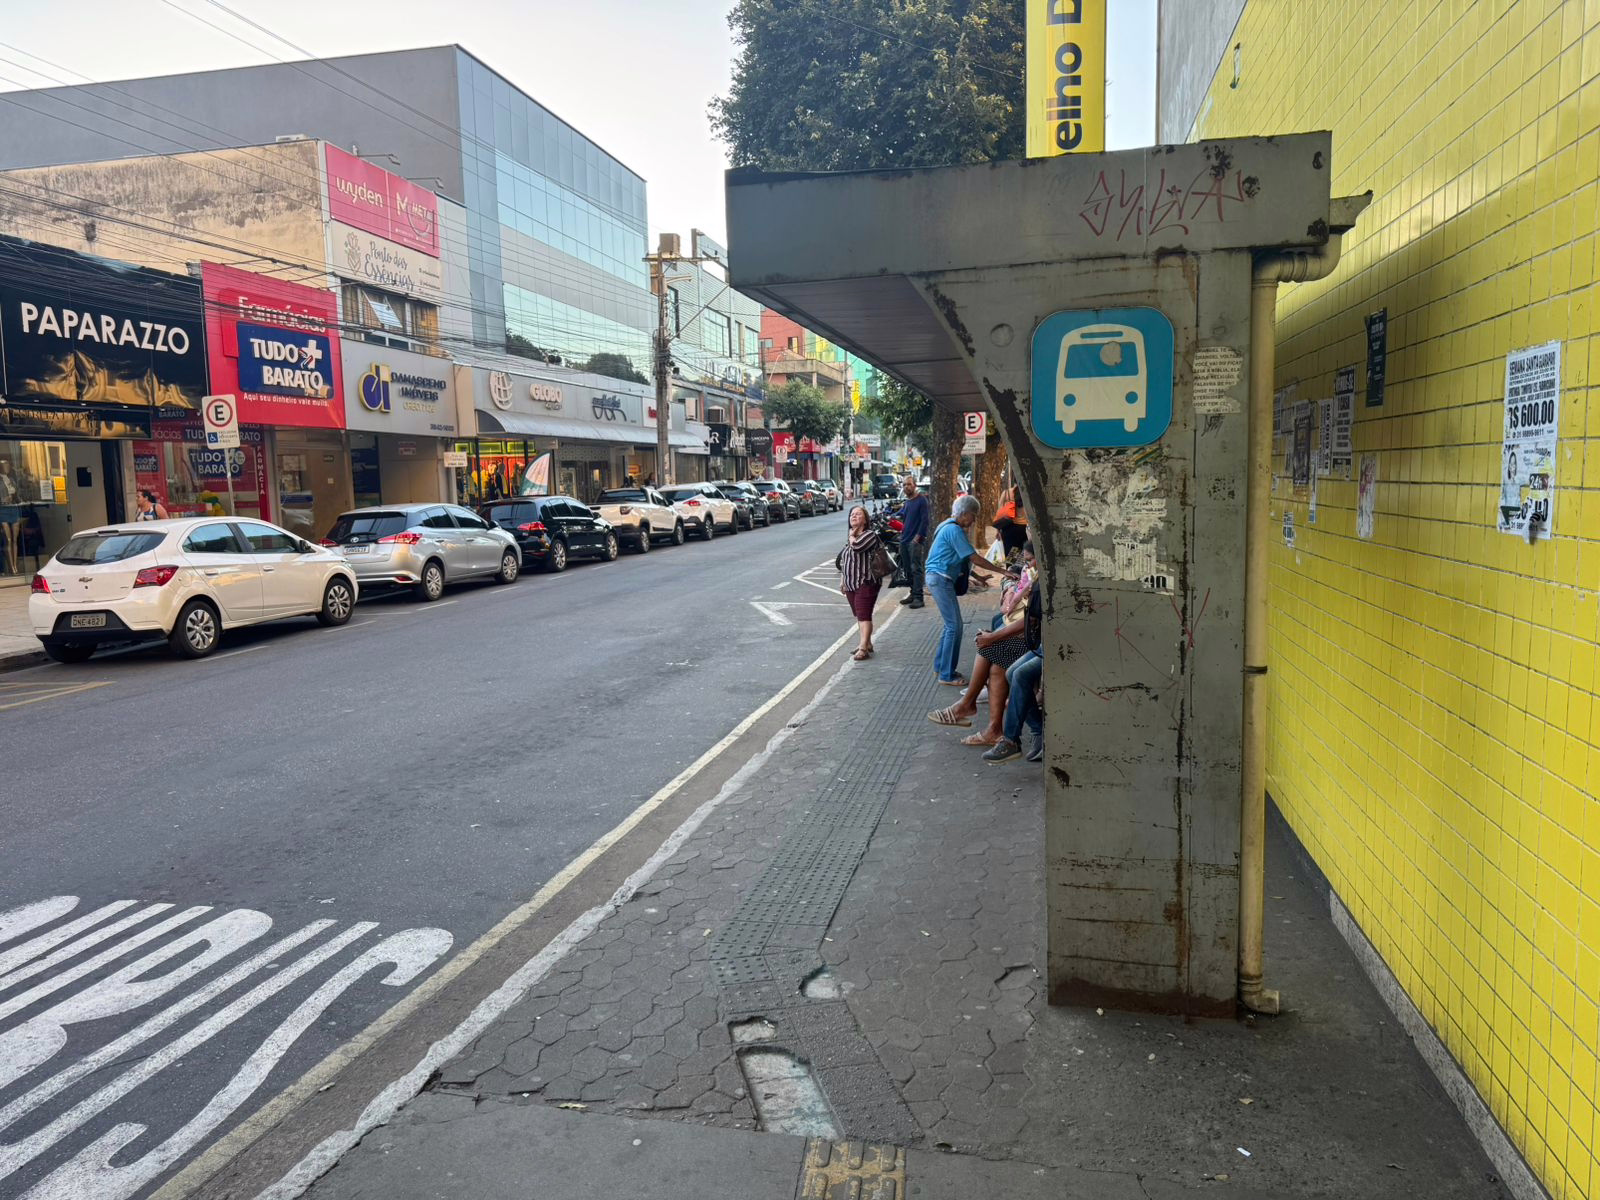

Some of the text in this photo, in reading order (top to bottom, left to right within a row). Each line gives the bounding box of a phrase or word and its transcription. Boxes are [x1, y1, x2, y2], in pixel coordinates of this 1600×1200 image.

[237, 295, 327, 334] Farmácias
[20, 301, 190, 355] PAPARAZZO
[249, 337, 299, 364] TUDO
[262, 366, 325, 392] BARATO
[390, 371, 446, 391] DAMASCENO
[243, 391, 259, 400] Aqui
[272, 393, 297, 404] dinheiro
[399, 384, 438, 401] IMÓVEIS
[529, 382, 562, 403] GLOBO
[214, 404, 225, 421] E
[968, 415, 976, 429] E
[1521, 399, 1554, 428] 600,00
[190, 452, 221, 463] TUDO
